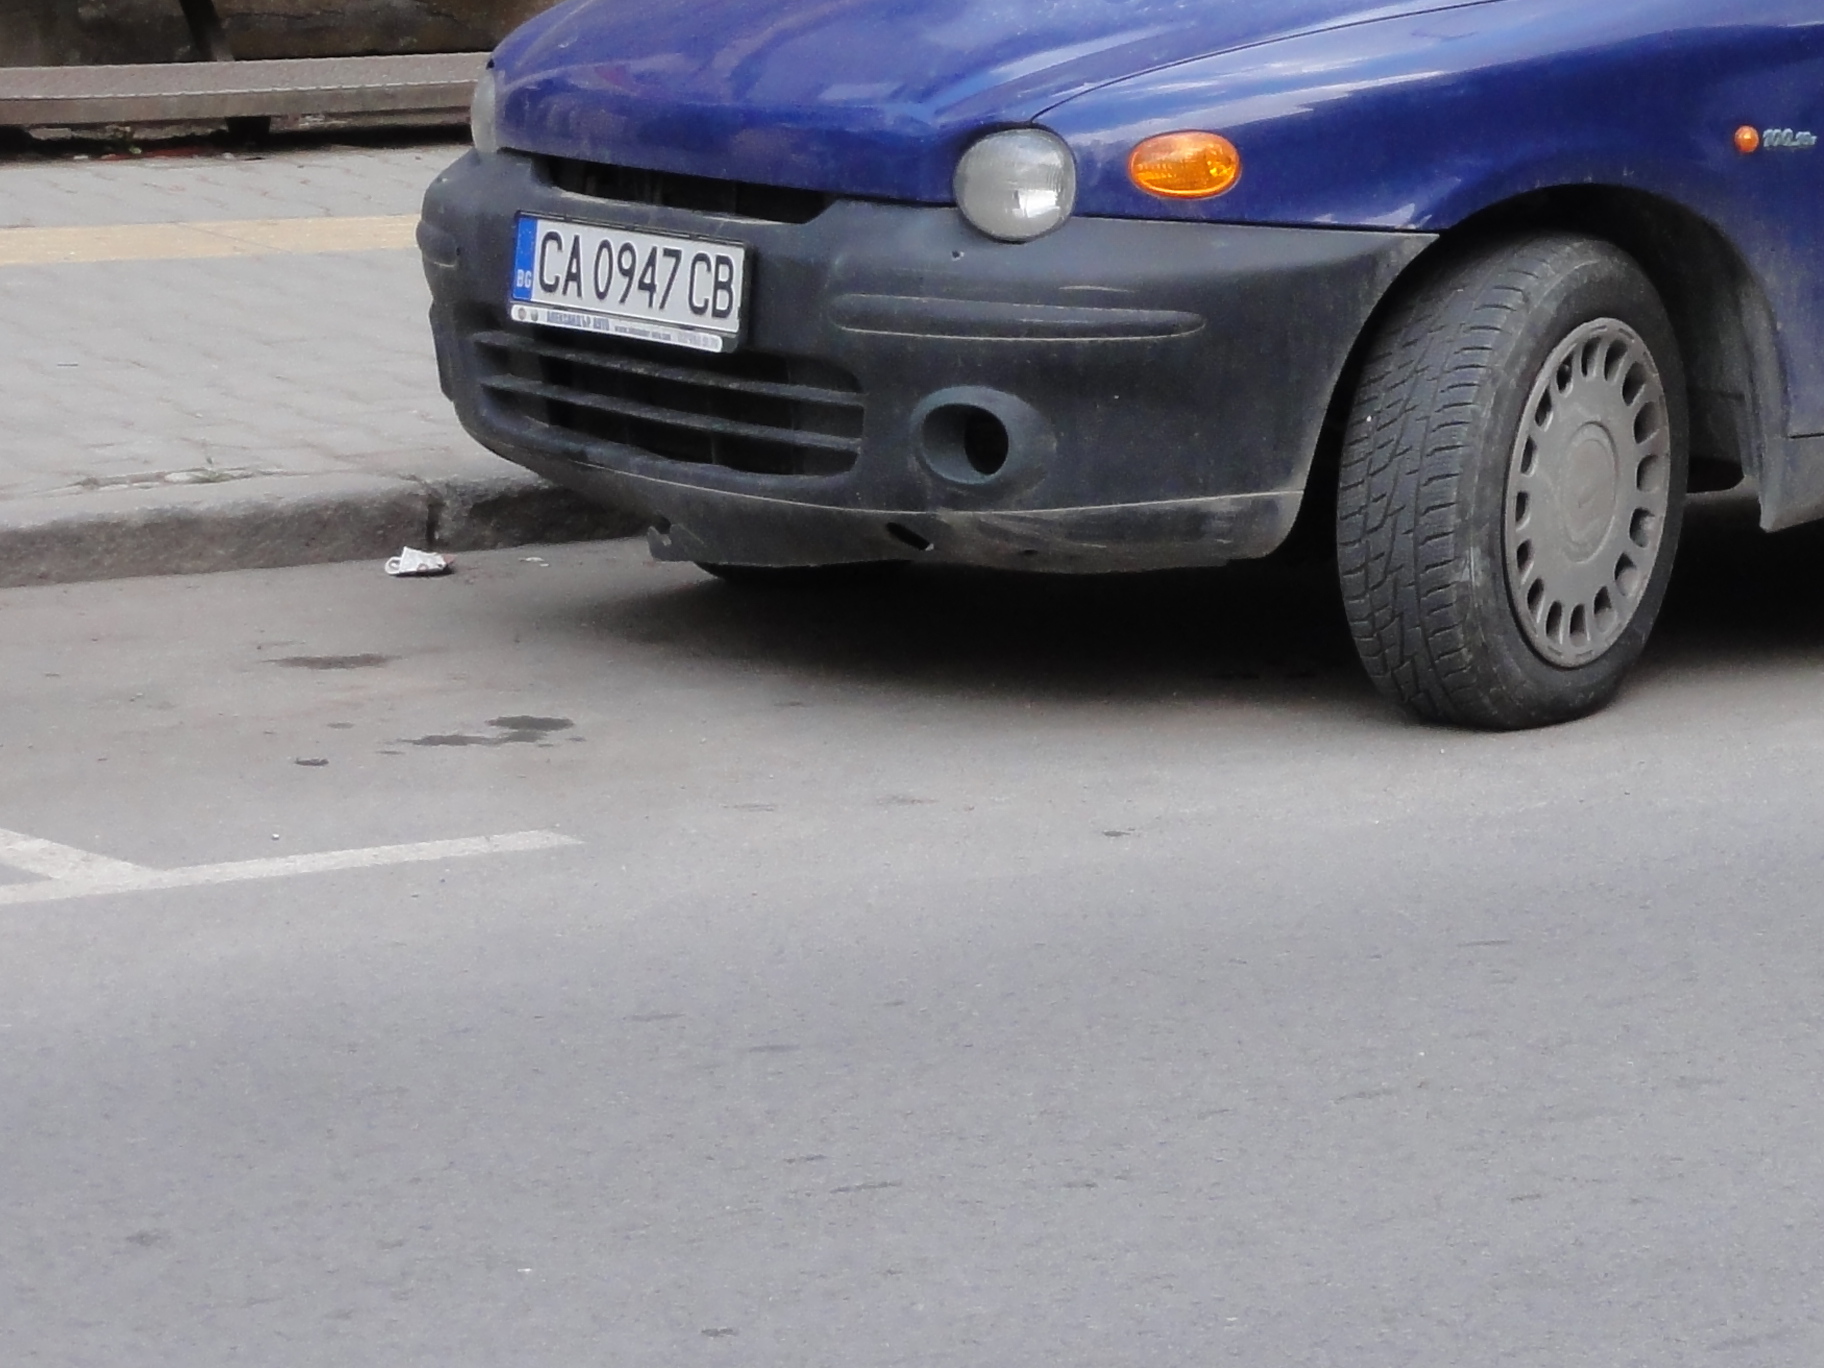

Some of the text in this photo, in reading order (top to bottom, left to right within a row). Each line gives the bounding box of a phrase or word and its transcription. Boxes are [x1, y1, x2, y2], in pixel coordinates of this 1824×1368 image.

[517, 268, 532, 288] BG
[538, 230, 734, 319] CA 0947 CB
